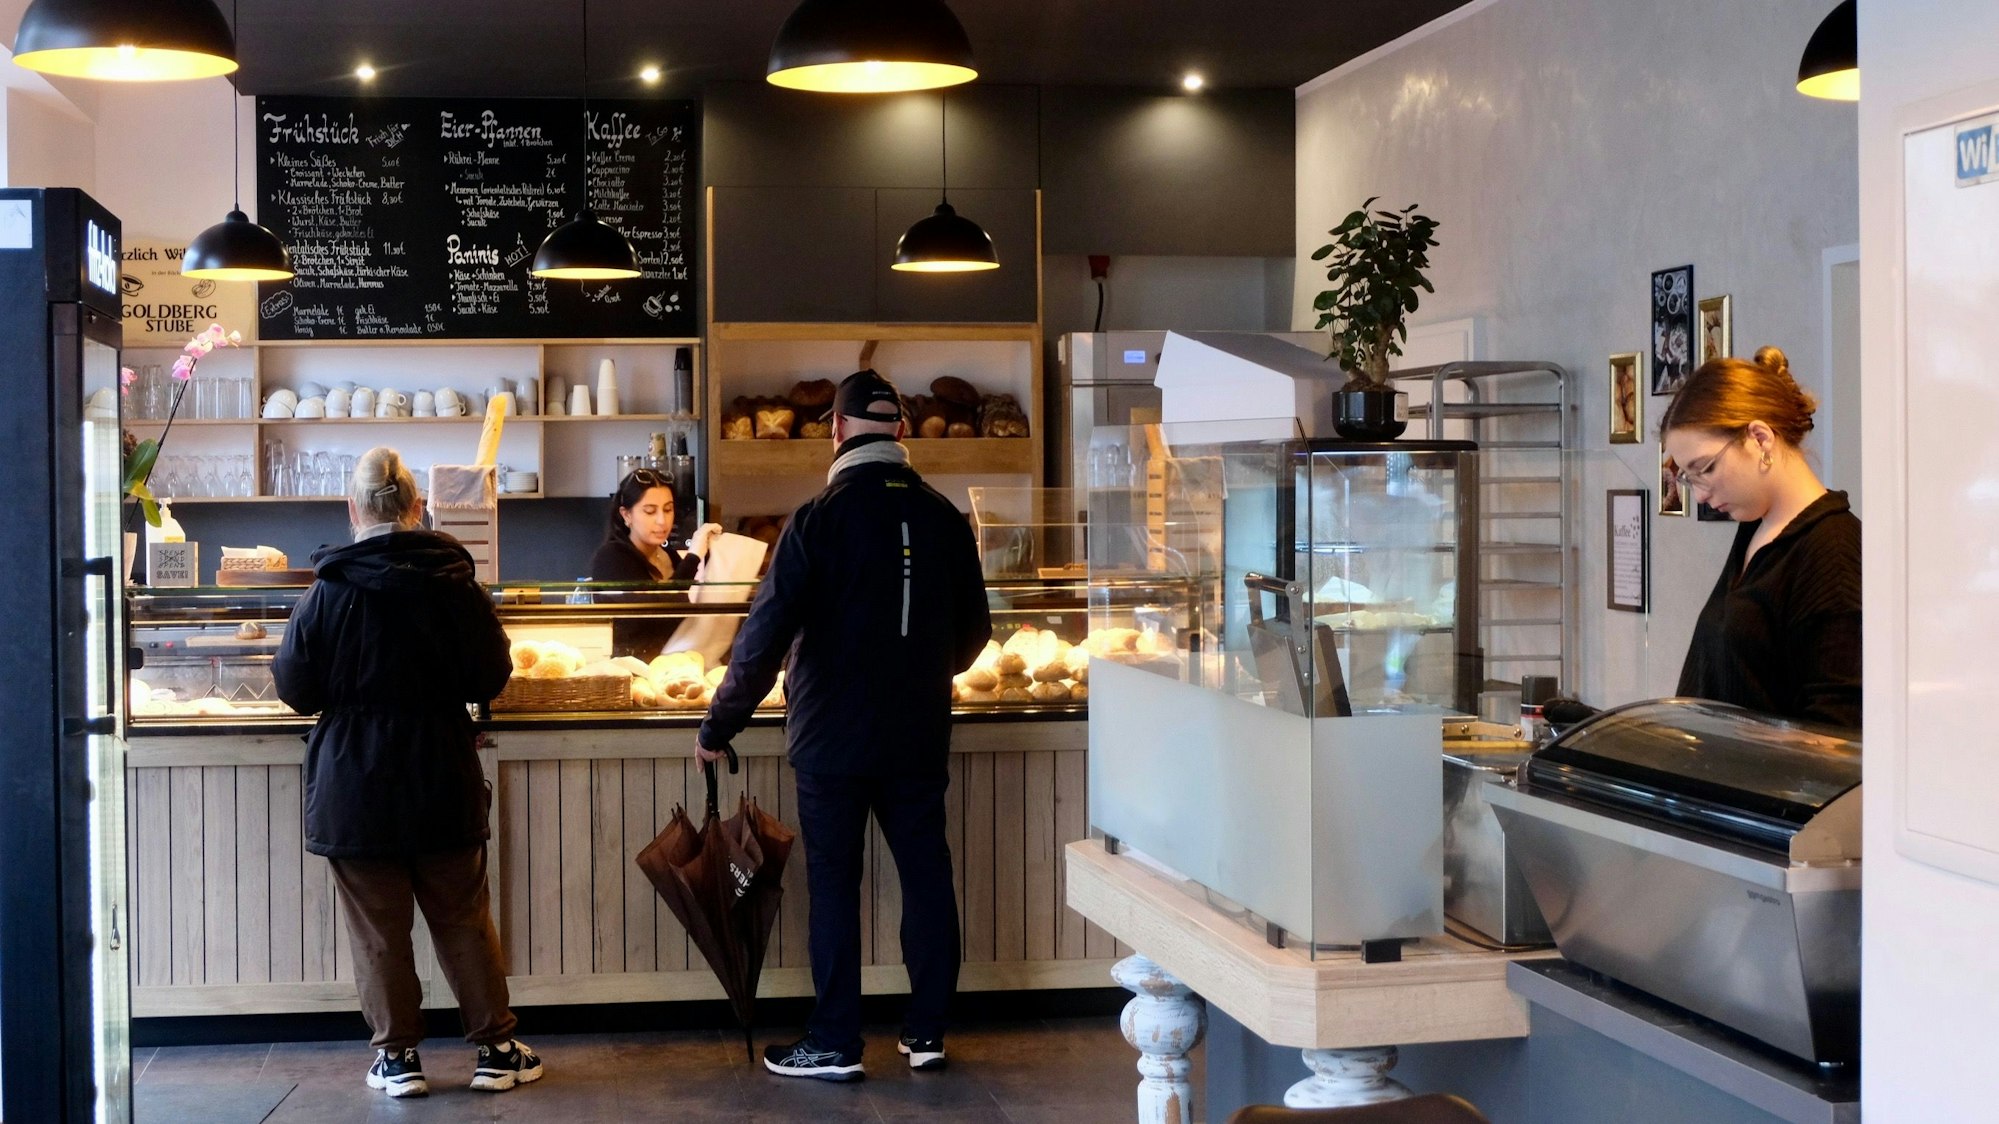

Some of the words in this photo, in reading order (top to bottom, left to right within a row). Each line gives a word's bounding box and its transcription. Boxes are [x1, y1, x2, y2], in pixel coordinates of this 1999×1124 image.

[263, 112, 360, 144] Frühstück
[440, 110, 542, 148] Eier-Pfannen
[587, 110, 641, 149] Kaffee
[365, 129, 389, 148] Frisch
[277, 151, 308, 167] Kleines
[310, 150, 336, 168] Süßes
[592, 150, 614, 166] Kaffee
[289, 168, 324, 178] Croissant
[331, 166, 366, 178] Weckchen
[591, 163, 631, 178] Cappuccino
[290, 177, 330, 189] Marmelade,
[381, 176, 405, 189] Butter
[278, 190, 329, 205] Klassisches
[330, 190, 371, 205] Frühstück
[593, 187, 630, 201] Milchkaffee
[593, 199, 611, 211] Latte
[631, 225, 663, 240] Espresso
[121, 247, 158, 261] rzlich
[328, 240, 372, 256] Frühstück
[447, 234, 499, 265] Paninis
[390, 266, 409, 277] Käse
[454, 269, 471, 281] Käse
[475, 267, 506, 281] Schinken
[455, 280, 519, 292] Tomate-Mozzarella
[121, 304, 217, 319] GOLDBERG
[293, 304, 330, 317] Marmelade
[480, 303, 499, 314] Käse
[145, 319, 194, 332] STUBE
[294, 325, 315, 337] Honig
[356, 325, 377, 335] Butter
[156, 570, 188, 579] SAVE!
